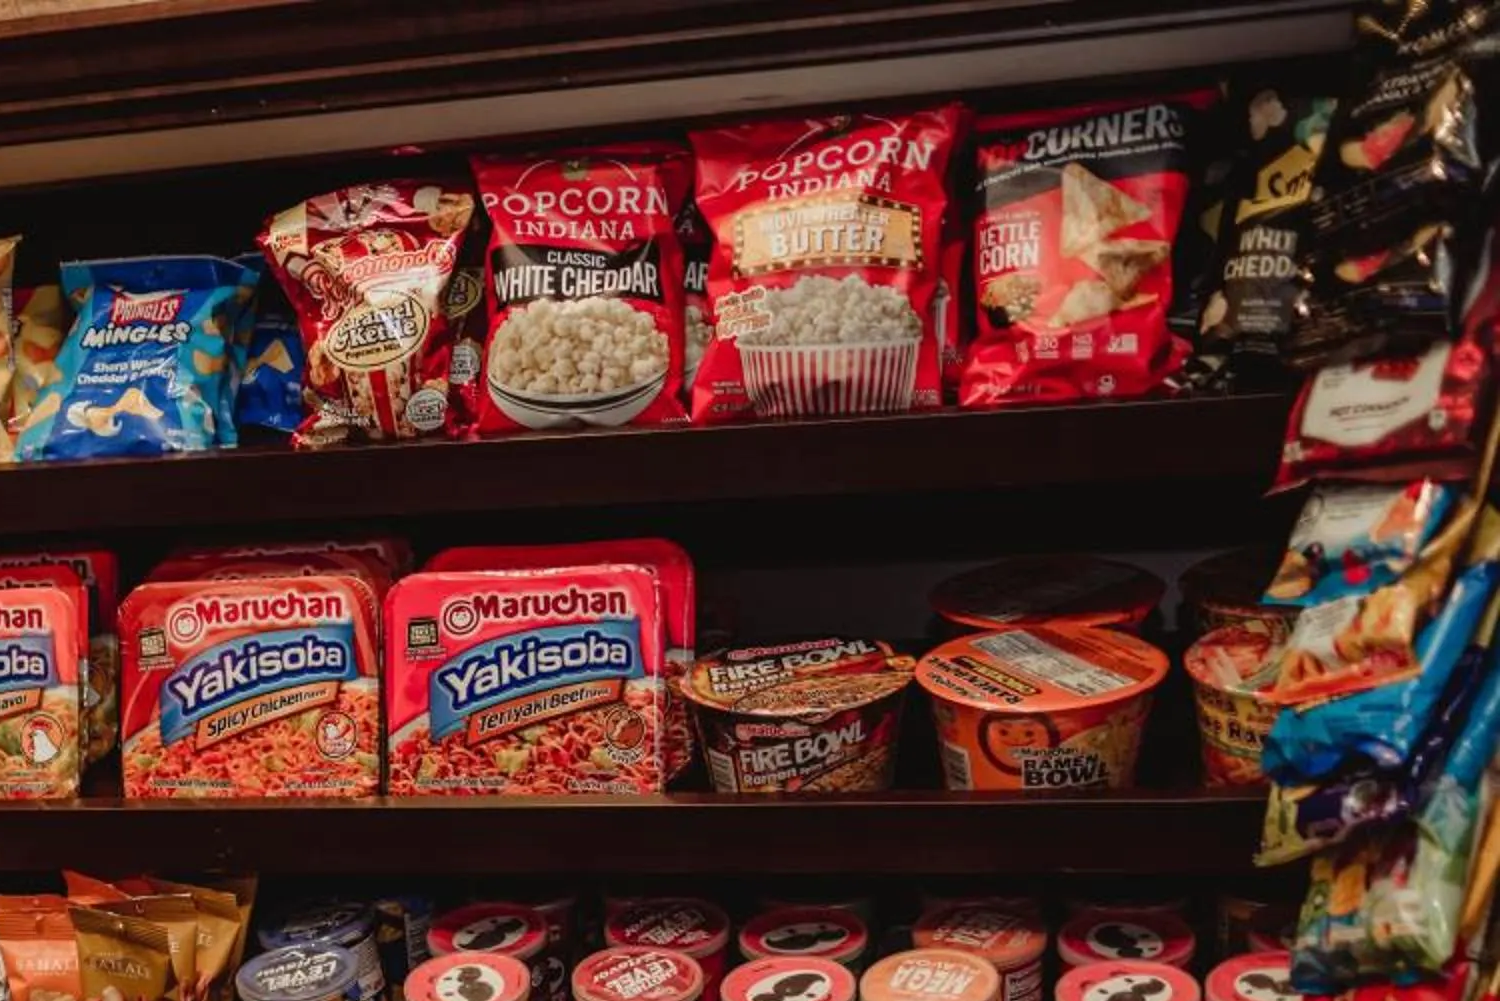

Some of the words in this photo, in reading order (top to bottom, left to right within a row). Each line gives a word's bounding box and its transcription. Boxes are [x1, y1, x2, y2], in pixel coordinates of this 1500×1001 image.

[736, 135, 935, 192] POPCORN
[482, 186, 669, 217] POPCORN
[767, 166, 892, 203] INDIANA
[514, 219, 635, 241] INDIANA
[770, 222, 885, 257] BUTTER
[980, 221, 1042, 249] KETTLE
[547, 250, 607, 269] CLASSIC
[980, 241, 1039, 276] CORN
[494, 265, 556, 302] WHITE
[561, 261, 659, 298] CHEDDAR
[113, 298, 179, 323] PRINGLES
[196, 592, 342, 625] Maruchan
[473, 587, 627, 619] Maruchan
[175, 635, 343, 710] Yakisoba
[446, 635, 627, 704] Yakisoba
[709, 659, 780, 683] FIRE
[781, 639, 877, 667] BOWL
[206, 707, 251, 737] Spicy
[250, 691, 304, 720] Chicken
[477, 699, 549, 734] Teriyaki
[549, 688, 586, 710] Beef
[740, 743, 793, 774] FIRE
[793, 720, 867, 765] BOWL
[1024, 754, 1099, 771] RAMEN
[1024, 763, 1109, 787] BOWL
[889, 966, 975, 995] MEGA
